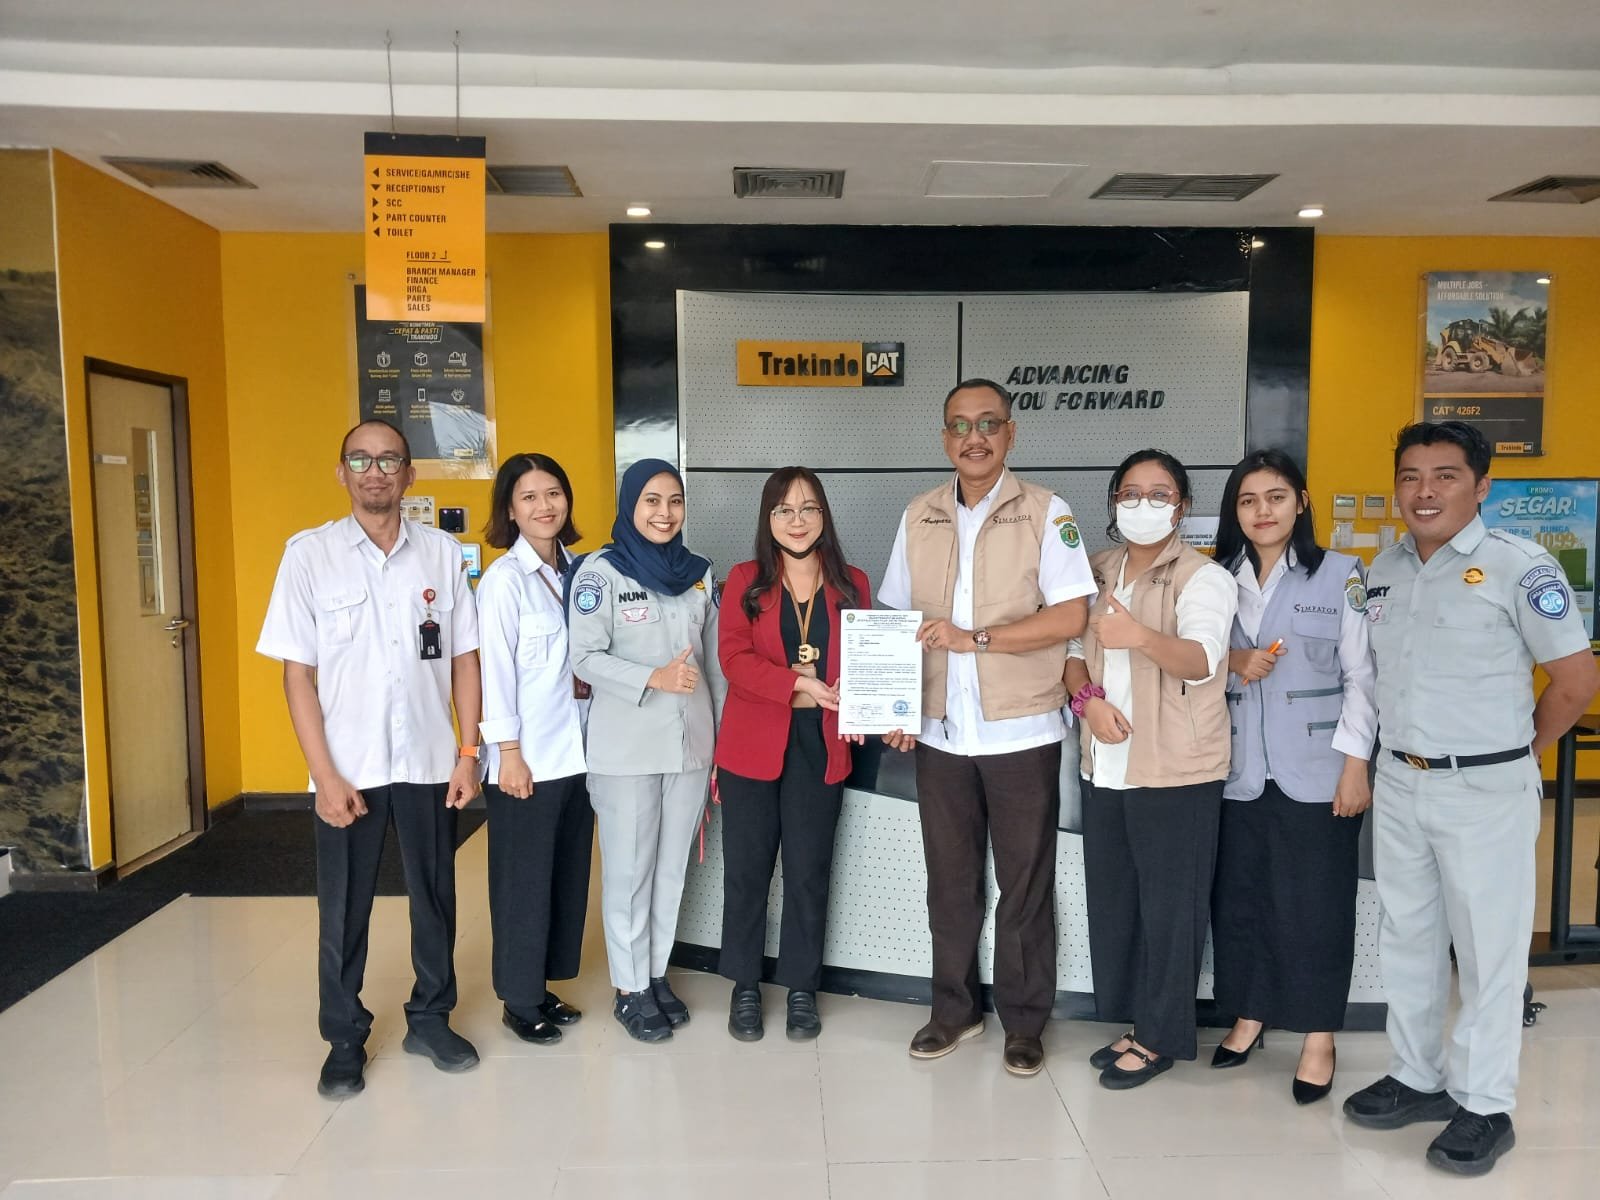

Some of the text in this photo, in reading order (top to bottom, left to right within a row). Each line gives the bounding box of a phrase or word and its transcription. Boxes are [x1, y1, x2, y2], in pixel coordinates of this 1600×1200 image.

[386, 199, 402, 207] SCC
[386, 214, 446, 223] PART COUNTER
[387, 228, 413, 237] TOILET
[406, 251, 436, 260] FLOOR 2
[406, 267, 476, 276] BRANCH MANAGER
[406, 276, 438, 285] FINANCE
[406, 285, 427, 293] HRGA
[407, 303, 431, 311] SALES
[758, 351, 899, 377] Trakindo CAT
[1006, 364, 1129, 385] ADVANCING
[1007, 389, 1165, 411] YOU FORWARD
[1500, 497, 1577, 518] SEGAR!
[619, 592, 648, 603] NUNI
